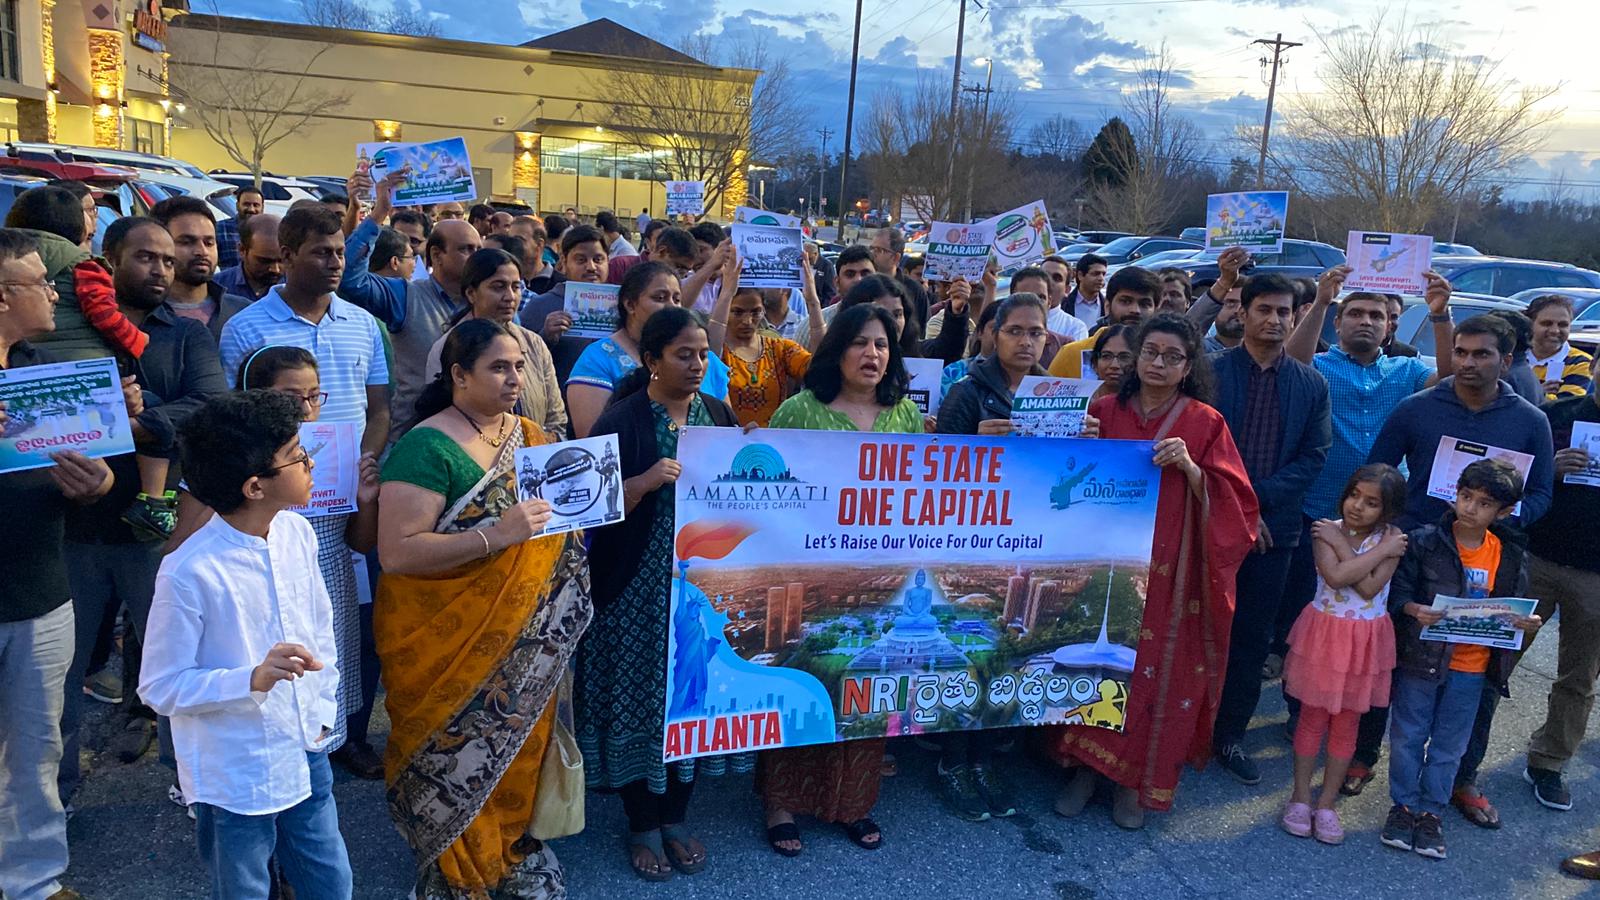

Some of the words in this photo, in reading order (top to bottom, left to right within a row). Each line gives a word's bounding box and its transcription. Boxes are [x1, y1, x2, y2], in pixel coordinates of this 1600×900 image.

[935, 244, 987, 255] AMARAVATI
[1020, 398, 1082, 409] AMARAVATI
[859, 443, 915, 481] ONE
[923, 444, 1004, 482] STATE
[686, 485, 829, 501] AMARAVATI
[311, 497, 347, 508] PRADESH
[707, 501, 723, 509] THE
[728, 502, 768, 510] PEOPLE'S
[838, 488, 894, 526] ONE
[902, 488, 1013, 526] CAPITAL
[841, 534, 878, 549] Raise
[882, 534, 905, 549] Our
[909, 534, 942, 548] Voice
[947, 534, 967, 548] For
[971, 534, 993, 548] Our
[997, 534, 1043, 552] Capital
[842, 675, 909, 716] NRI
[914, 671, 978, 723] రైతు
[665, 711, 781, 758] ATLANTA
